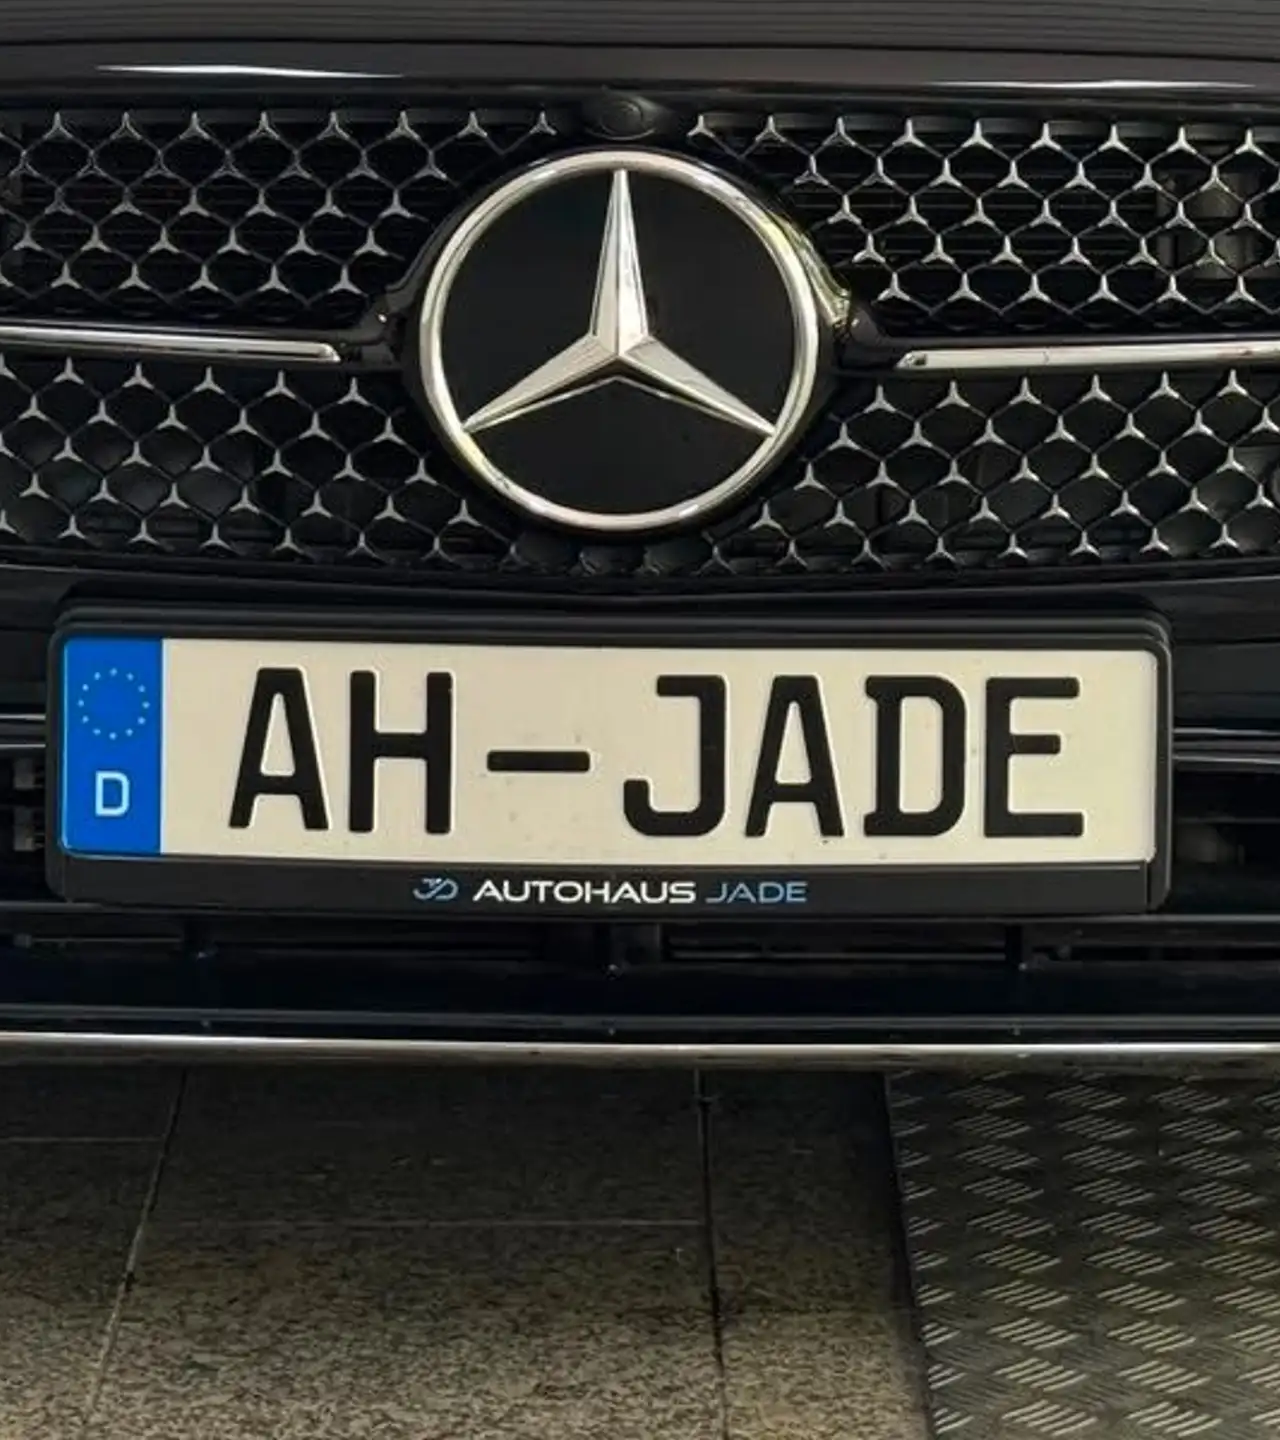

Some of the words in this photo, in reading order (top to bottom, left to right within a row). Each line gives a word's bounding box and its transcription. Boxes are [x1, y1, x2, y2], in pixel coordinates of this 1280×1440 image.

[94, 770, 130, 817] D
[472, 879, 697, 904] AUTOHAUS
[705, 880, 809, 904] JADE
